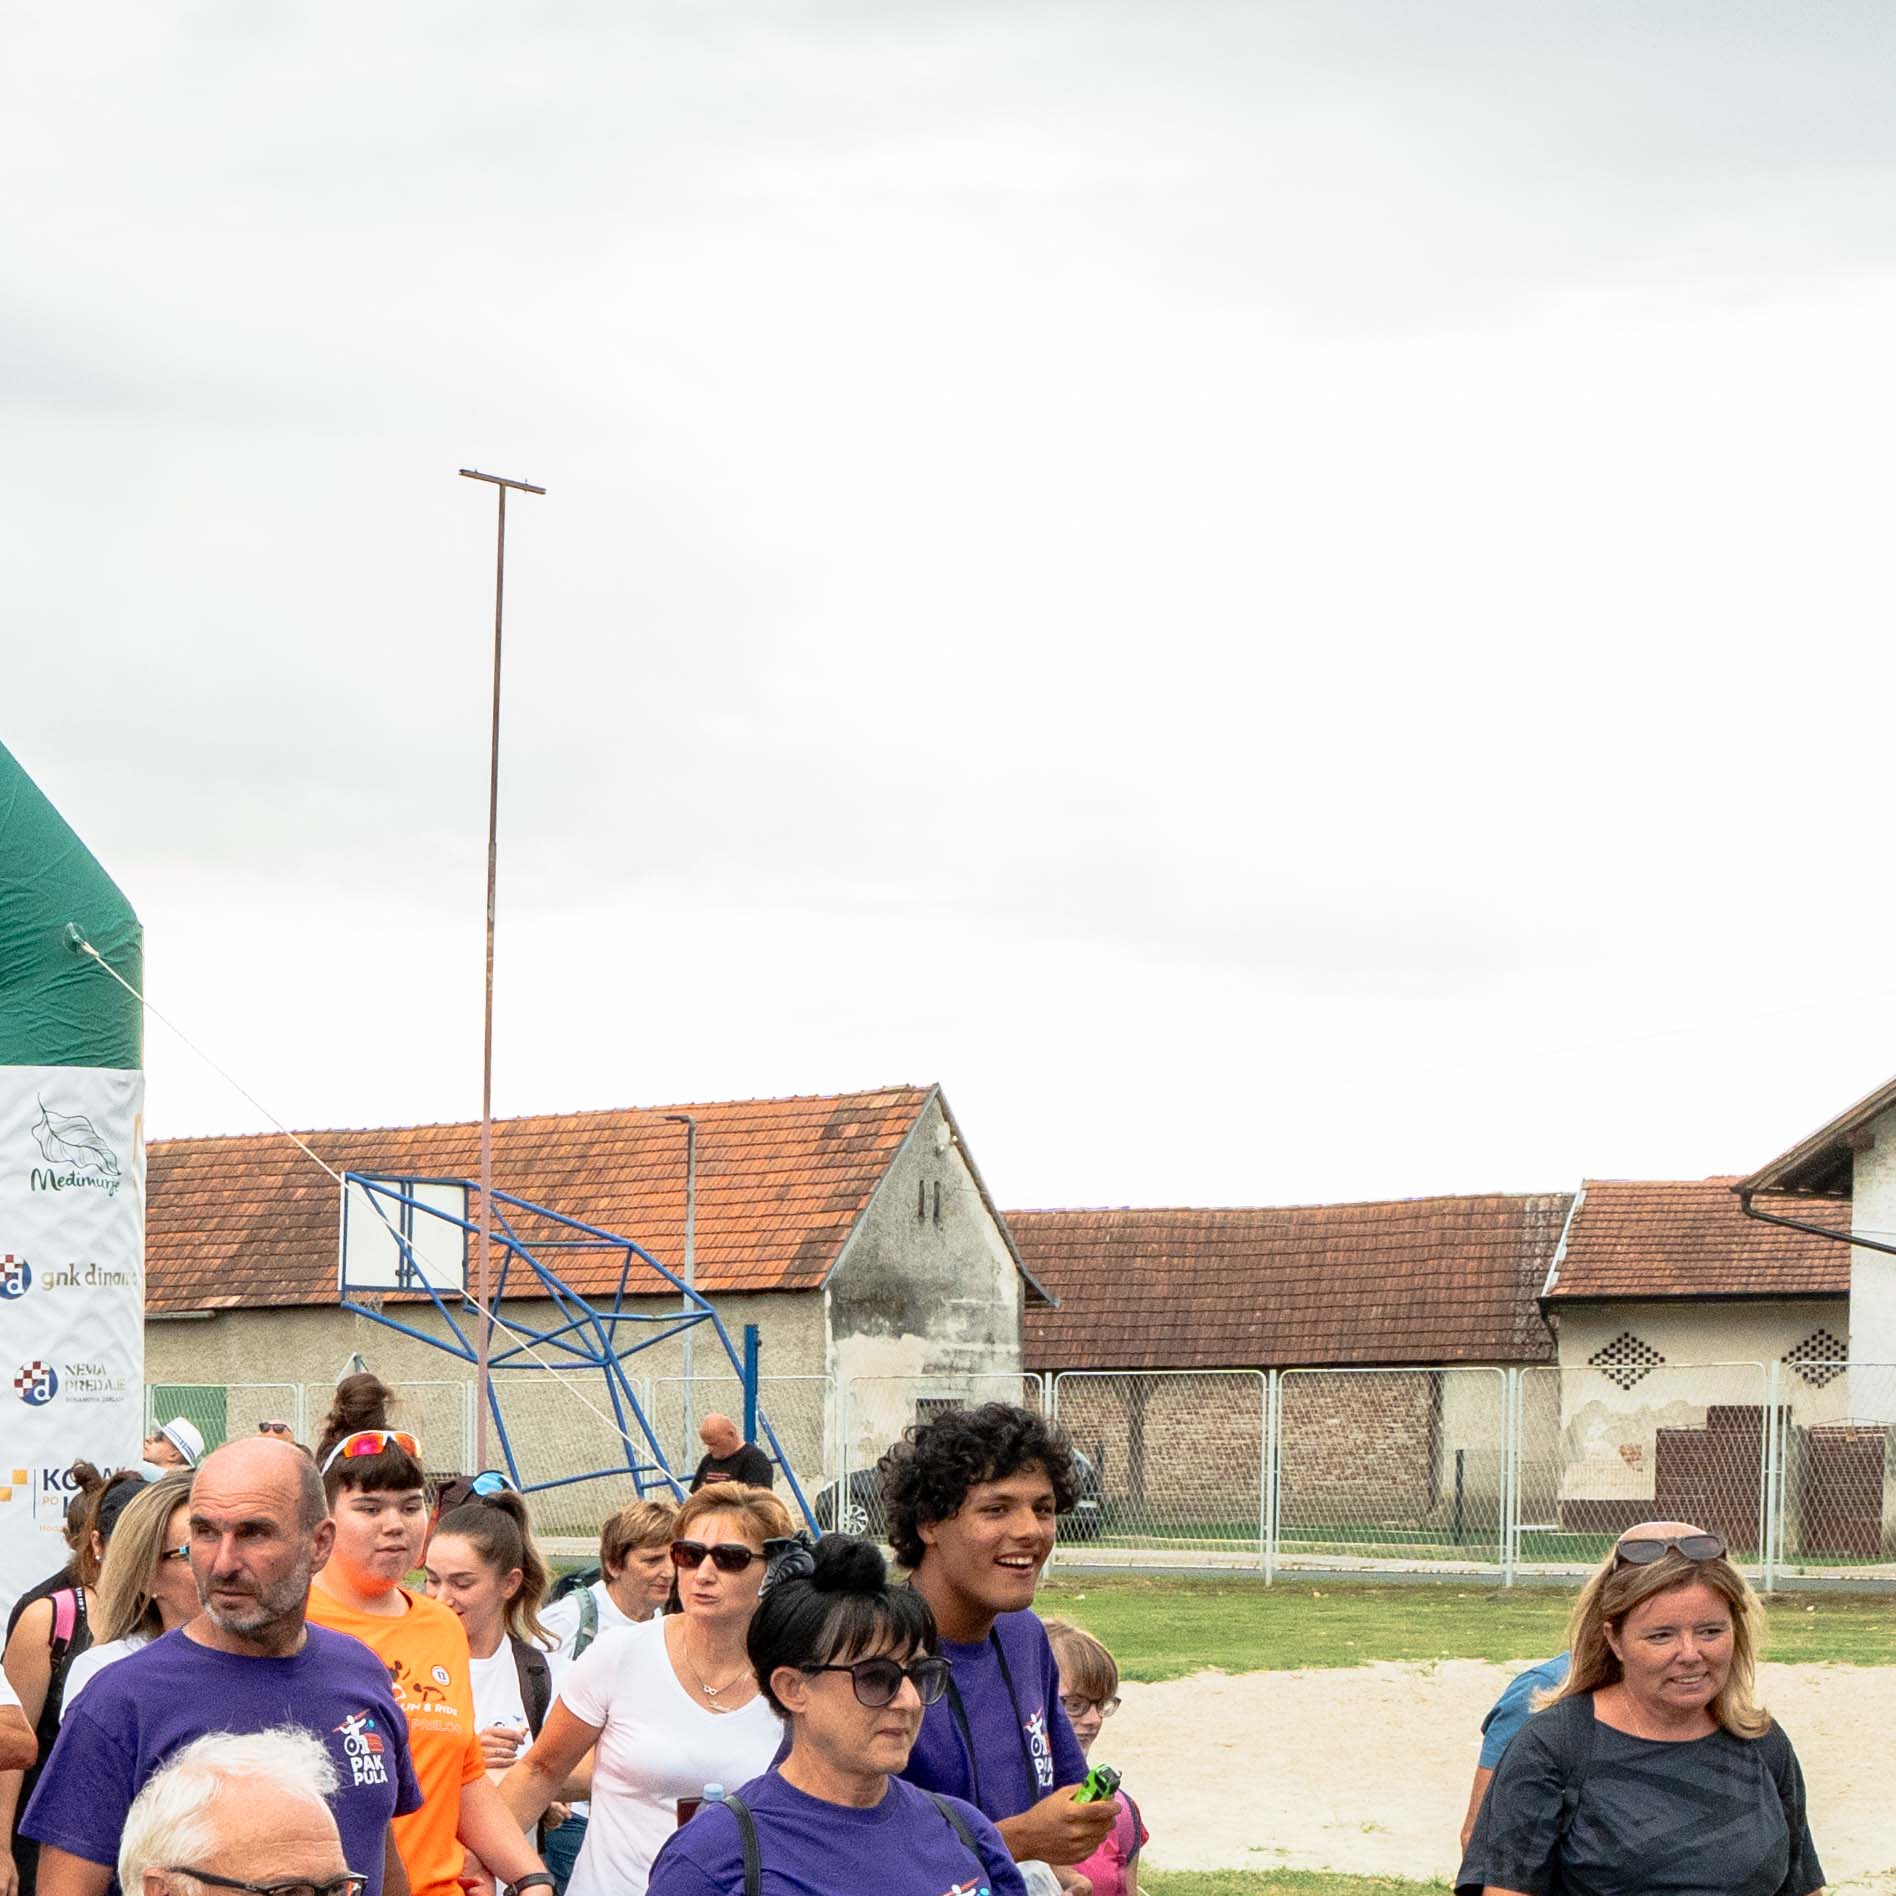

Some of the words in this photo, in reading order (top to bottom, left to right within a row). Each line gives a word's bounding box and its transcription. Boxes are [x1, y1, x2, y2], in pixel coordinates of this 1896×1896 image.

[41, 1263, 80, 1291] gnk
[350, 1754, 385, 1773] PAK
[353, 1769, 389, 1787] PULA
